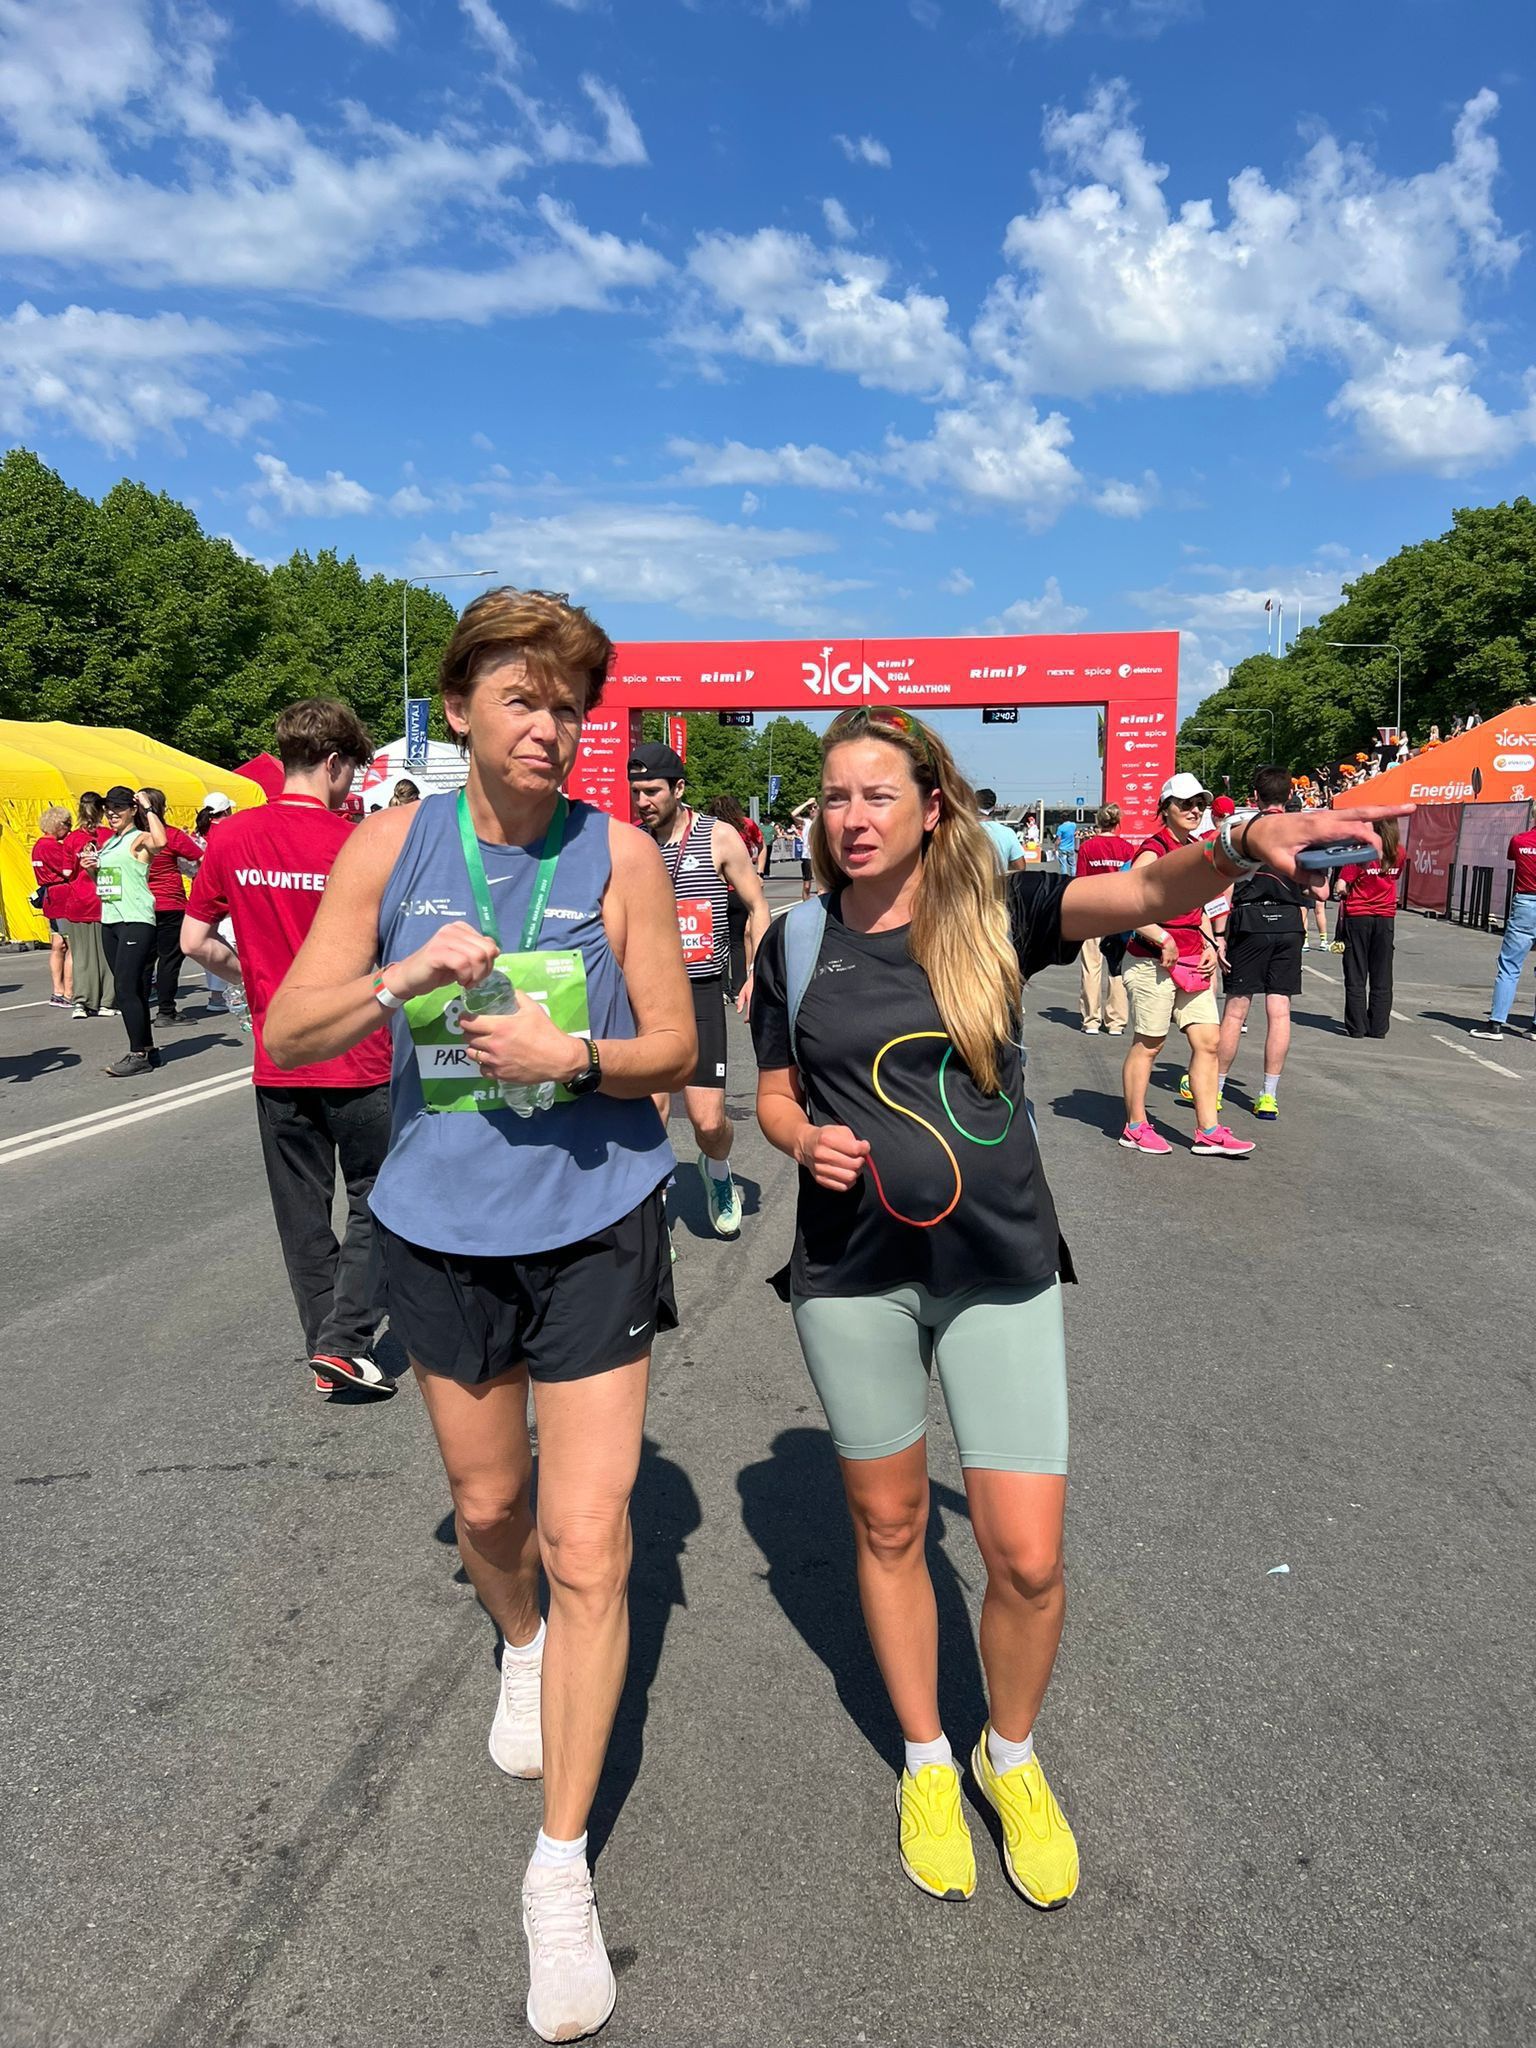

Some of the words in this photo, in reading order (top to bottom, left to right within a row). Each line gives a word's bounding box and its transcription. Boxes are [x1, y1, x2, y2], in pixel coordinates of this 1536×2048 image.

[969, 666, 1013, 679] Rimi
[1084, 667, 1112, 676] spice
[1133, 666, 1162, 675] elektrum
[622, 674, 648, 684] spice
[700, 671, 742, 684] Rimi
[887, 672, 910, 682] RIGA
[898, 684, 951, 695] MARATHON
[1120, 714, 1154, 724] Rimi
[1145, 730, 1167, 738] spice
[1410, 782, 1473, 799] Enerģija
[234, 868, 331, 892] VOLUNTEE
